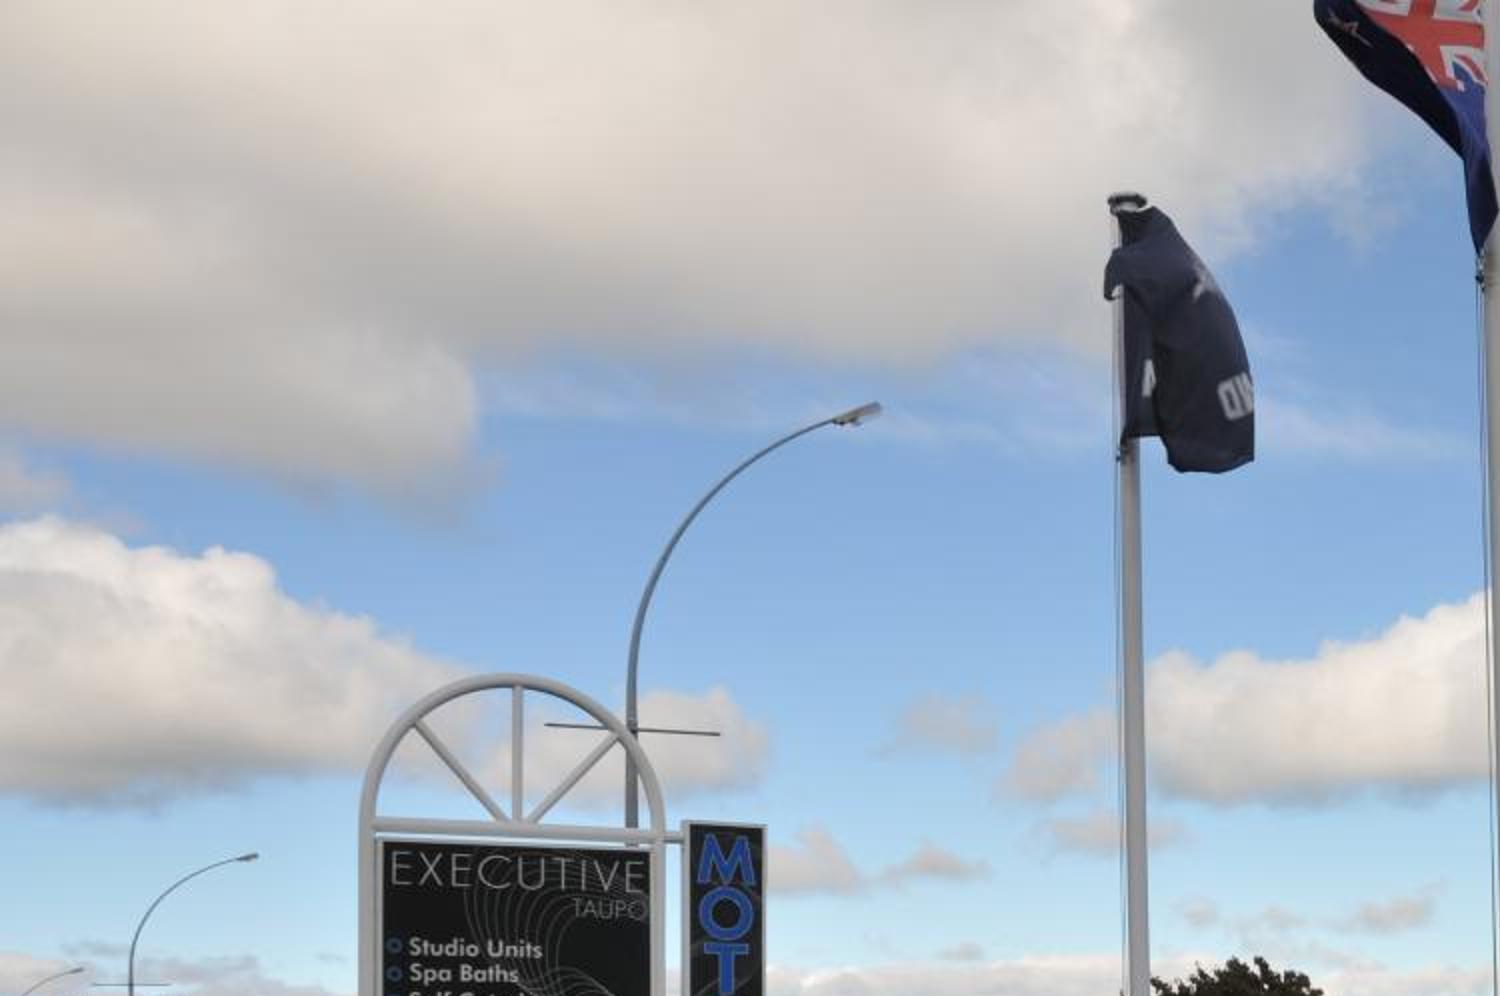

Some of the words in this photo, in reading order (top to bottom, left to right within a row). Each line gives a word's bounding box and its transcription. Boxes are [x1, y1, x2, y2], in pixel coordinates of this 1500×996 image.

[391, 852, 645, 893] EXECUTIVE
[573, 897, 648, 920] TAUPO
[409, 937, 479, 957] Studio
[487, 939, 543, 958] Units
[409, 963, 451, 985] Spa
[460, 964, 519, 983] Baths
